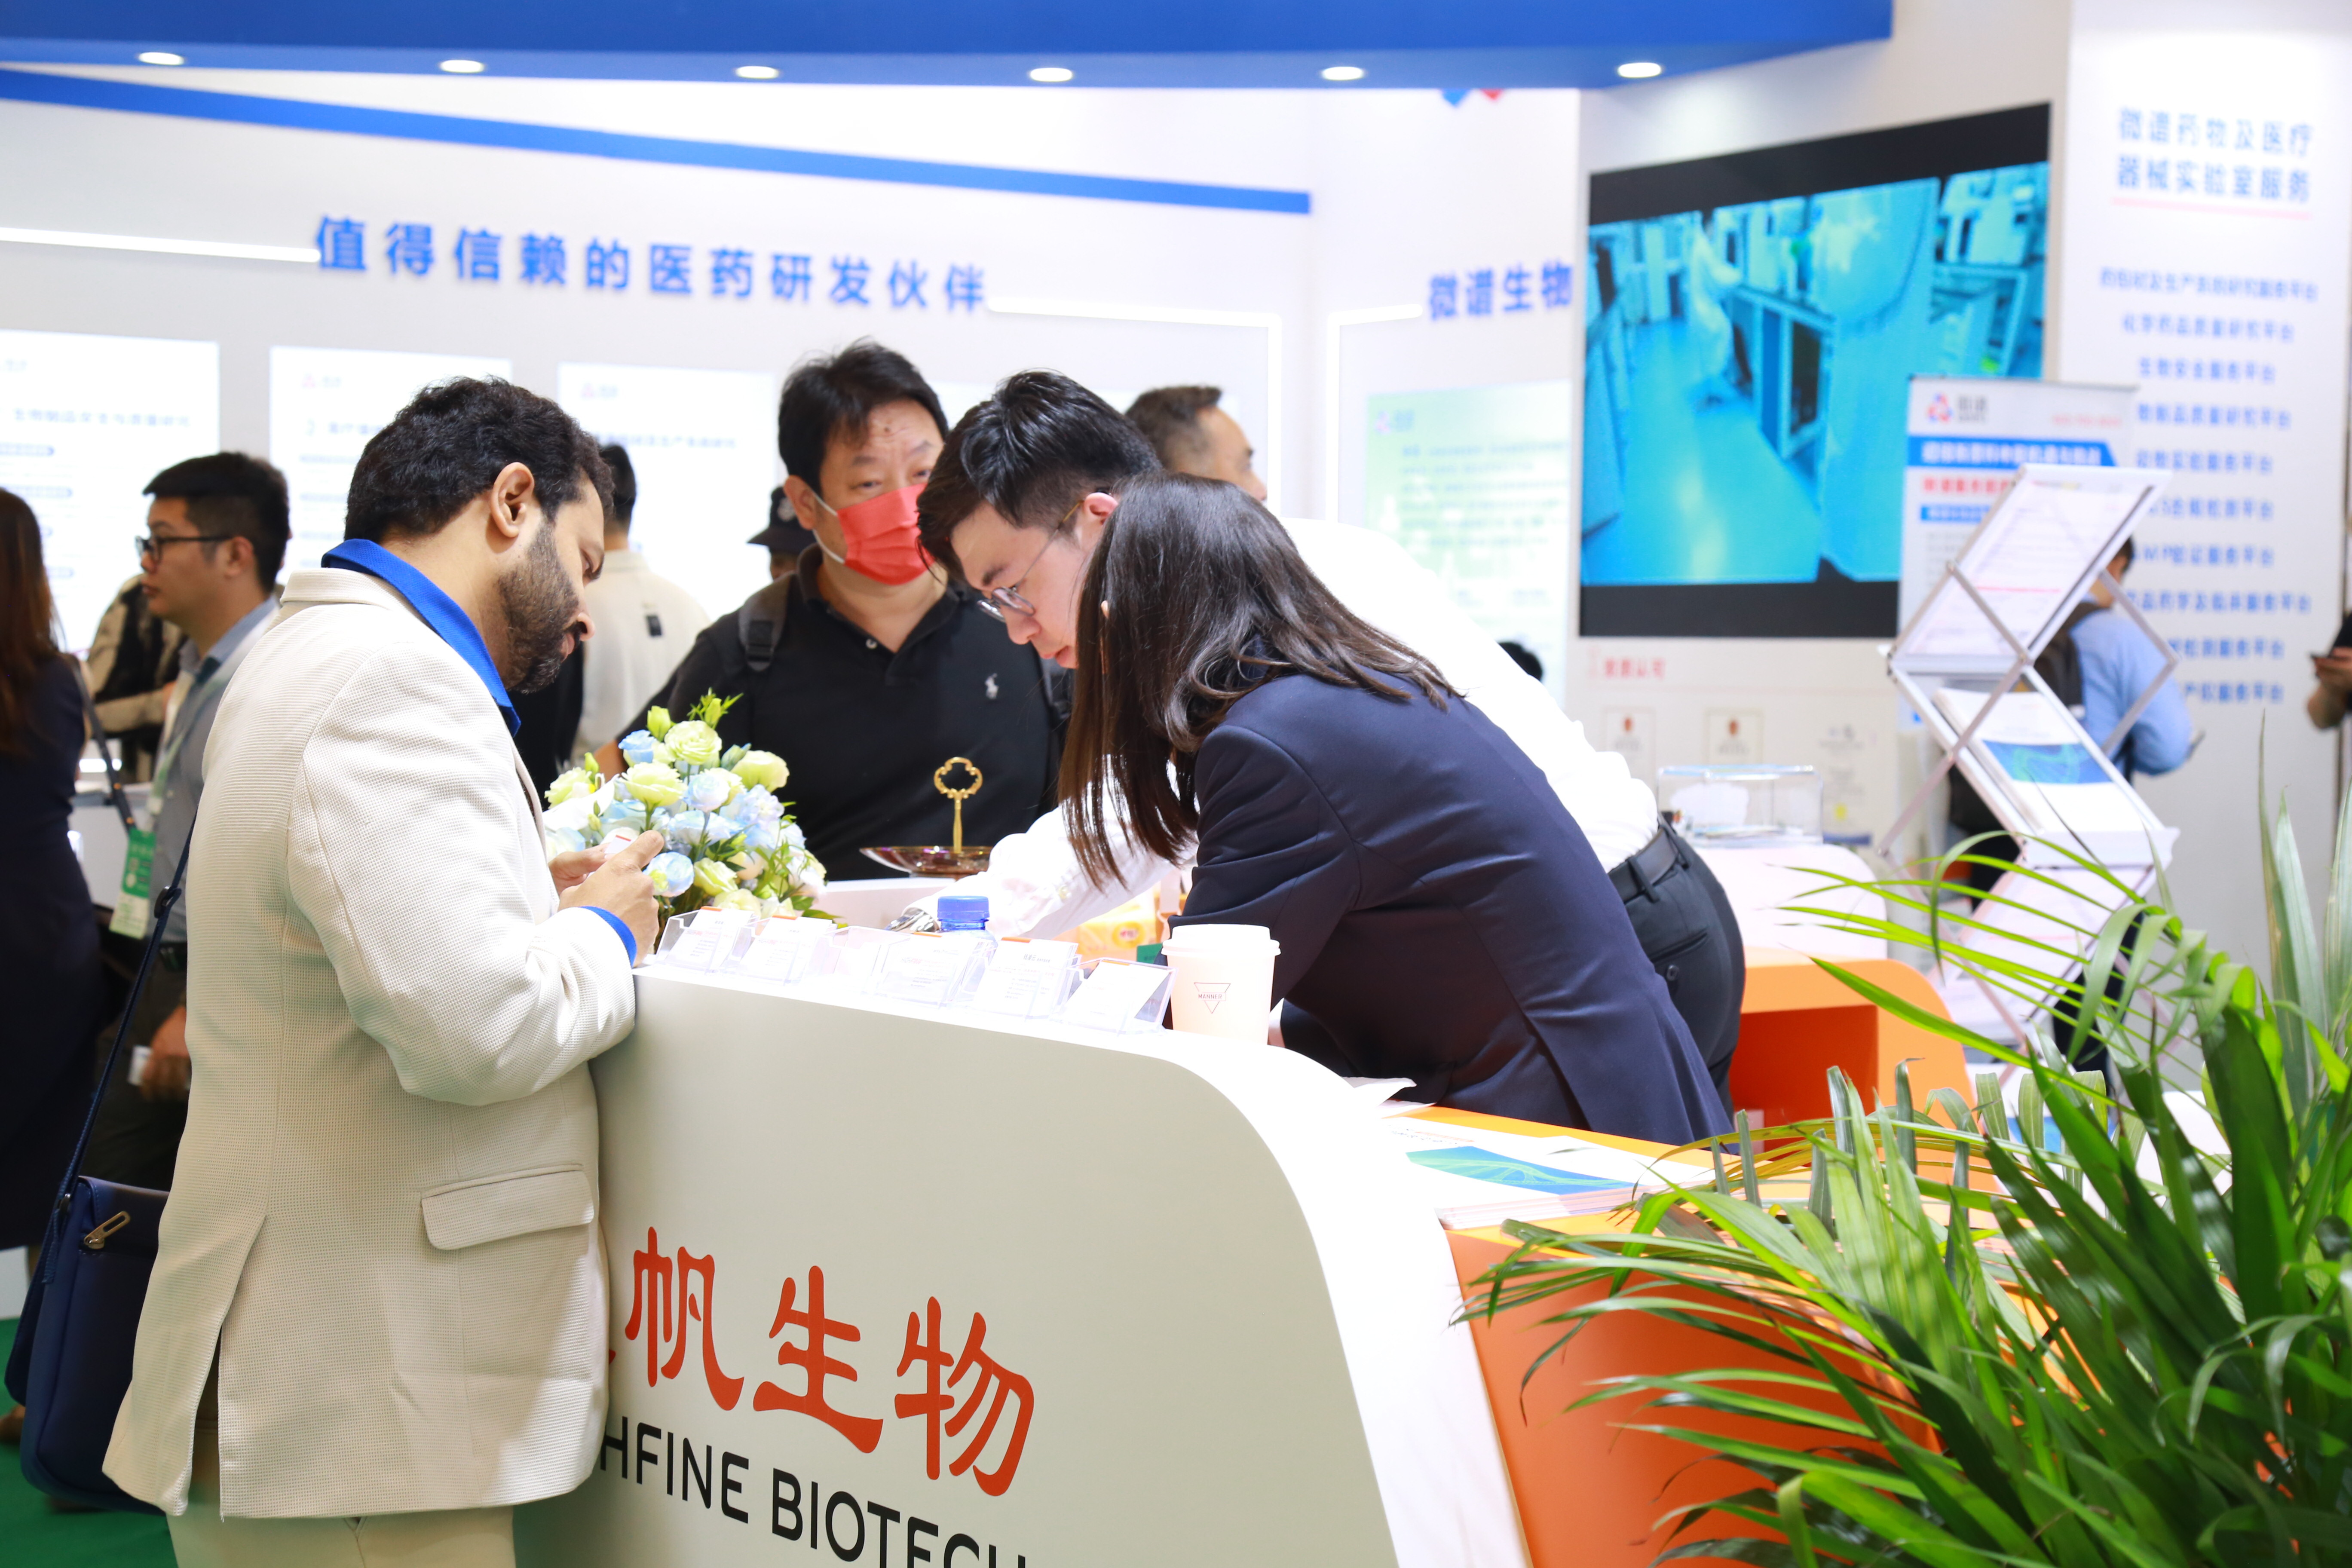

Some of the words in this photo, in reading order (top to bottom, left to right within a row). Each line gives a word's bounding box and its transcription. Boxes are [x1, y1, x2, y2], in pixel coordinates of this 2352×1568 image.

[2117, 153, 2310, 203] 器械实验室服务
[316, 215, 986, 312] 值得信赖的医药研发伙伴
[1428, 260, 1574, 321] 微谱生物
[609, 1226, 1034, 1496] 帆生物
[600, 1416, 749, 1524] HFINE
[772, 1467, 1026, 1568] BIOTEC
